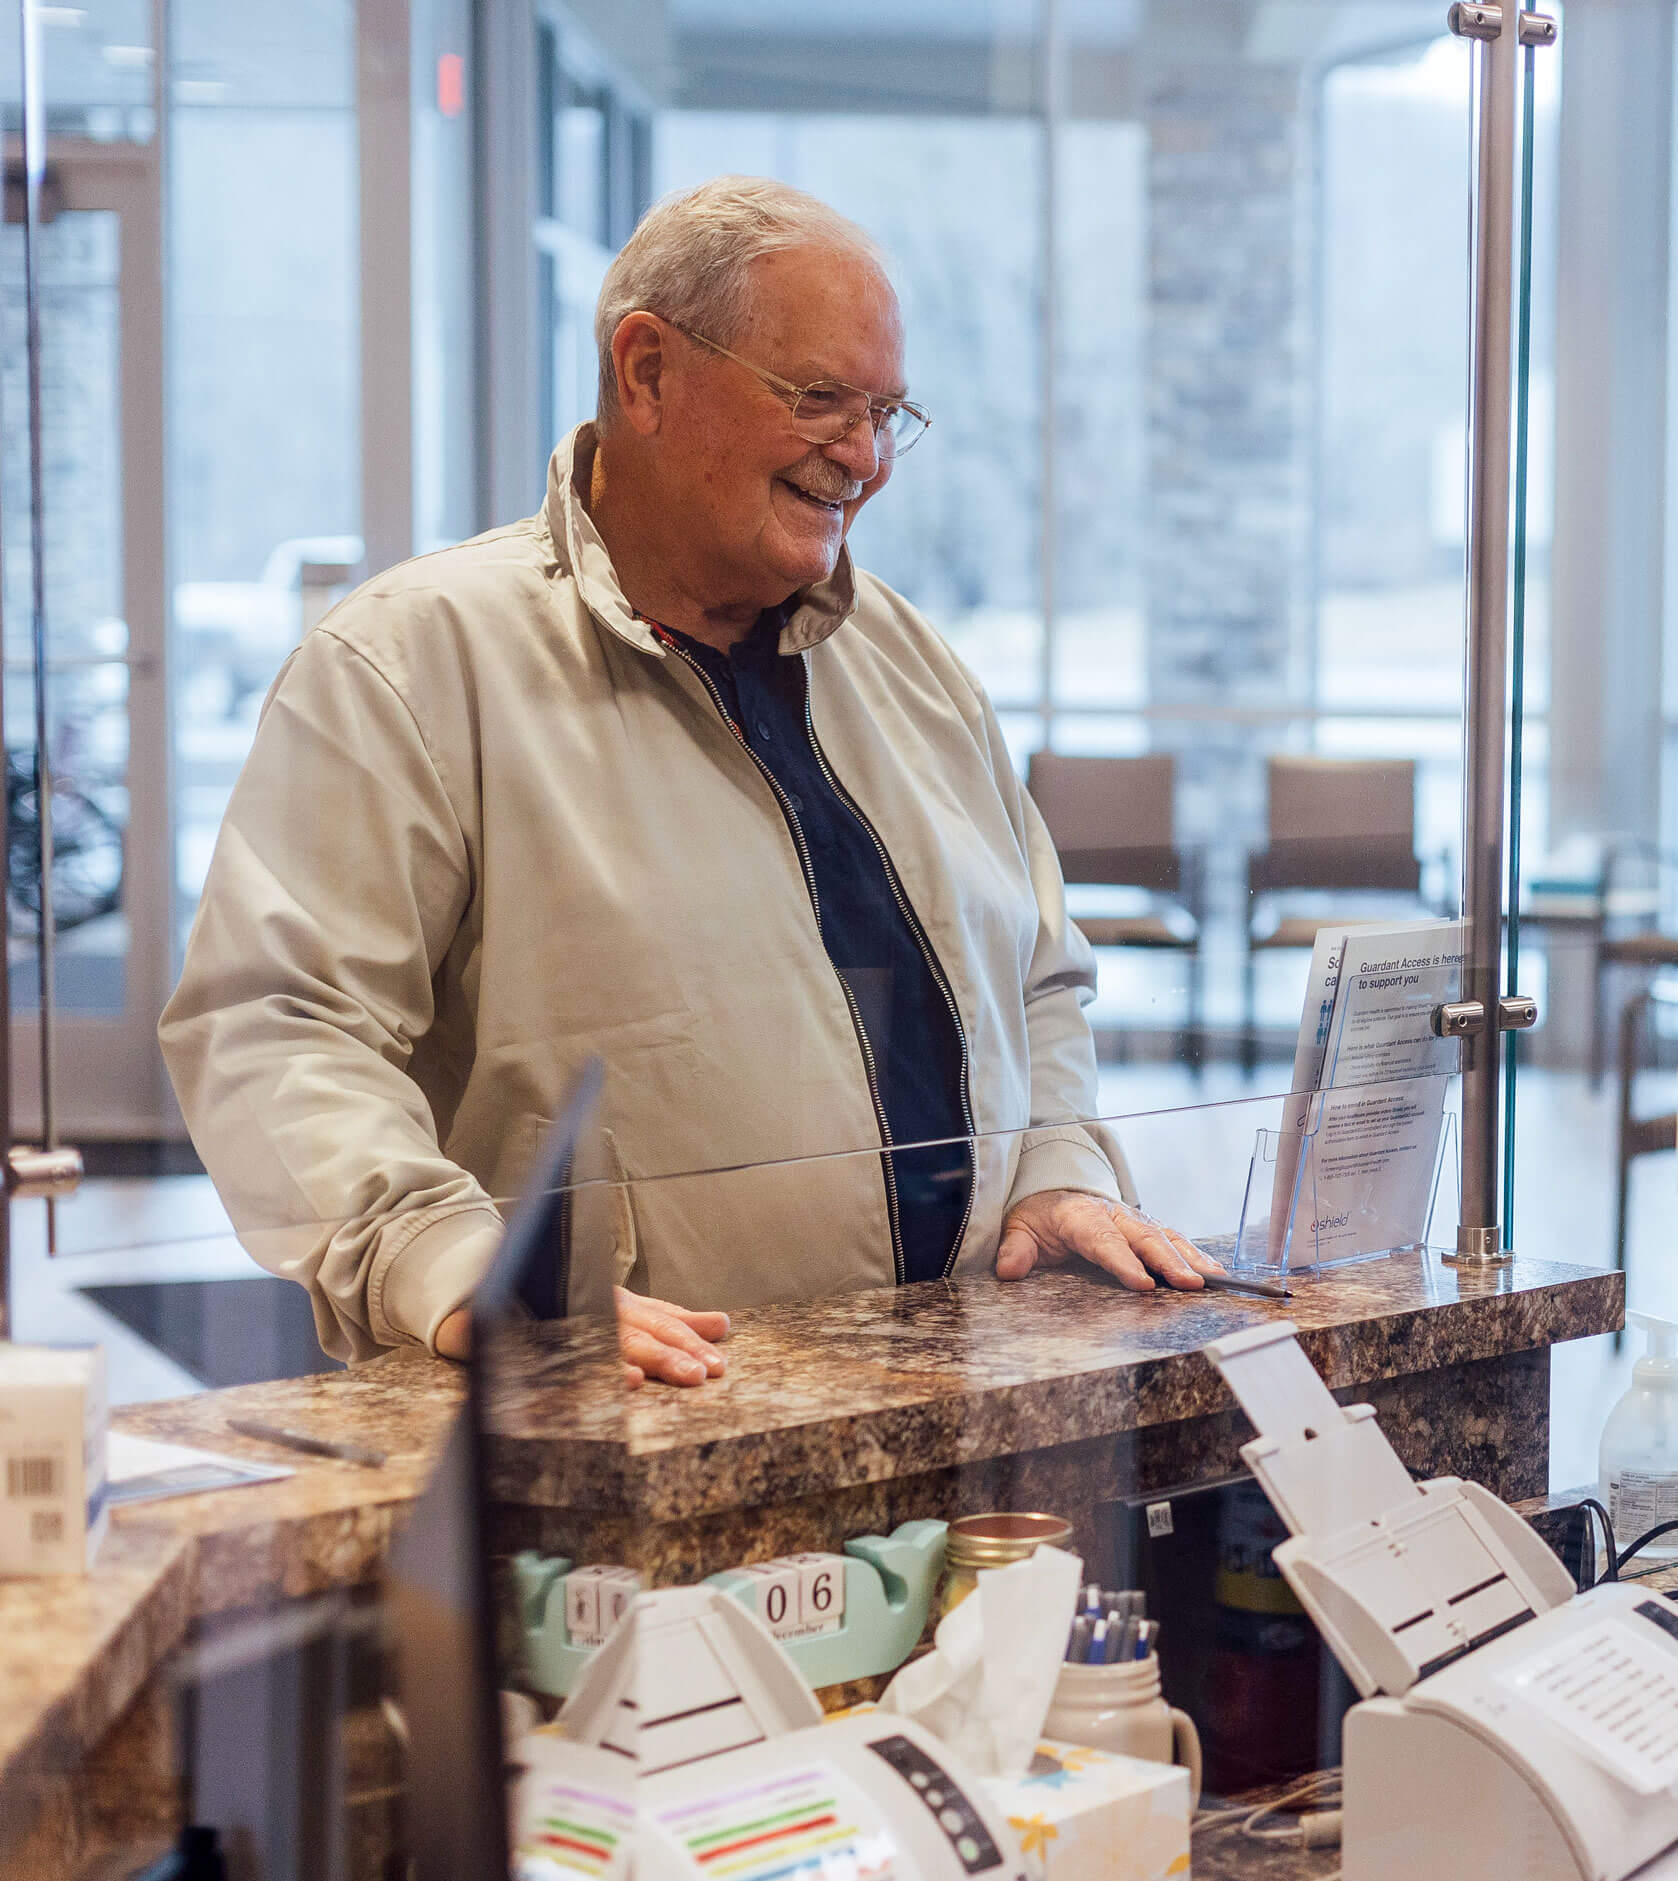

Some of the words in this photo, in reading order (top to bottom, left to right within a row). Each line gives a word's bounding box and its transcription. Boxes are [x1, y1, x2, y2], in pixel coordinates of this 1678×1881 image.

[1360, 960, 1399, 973] Guardant
[1401, 957, 1430, 969] Access
[1432, 955, 1440, 965] is
[1359, 979, 1367, 989] to
[1369, 976, 1402, 990] support
[1403, 974, 1419, 987] you
[1319, 1211, 1350, 1231] shield
